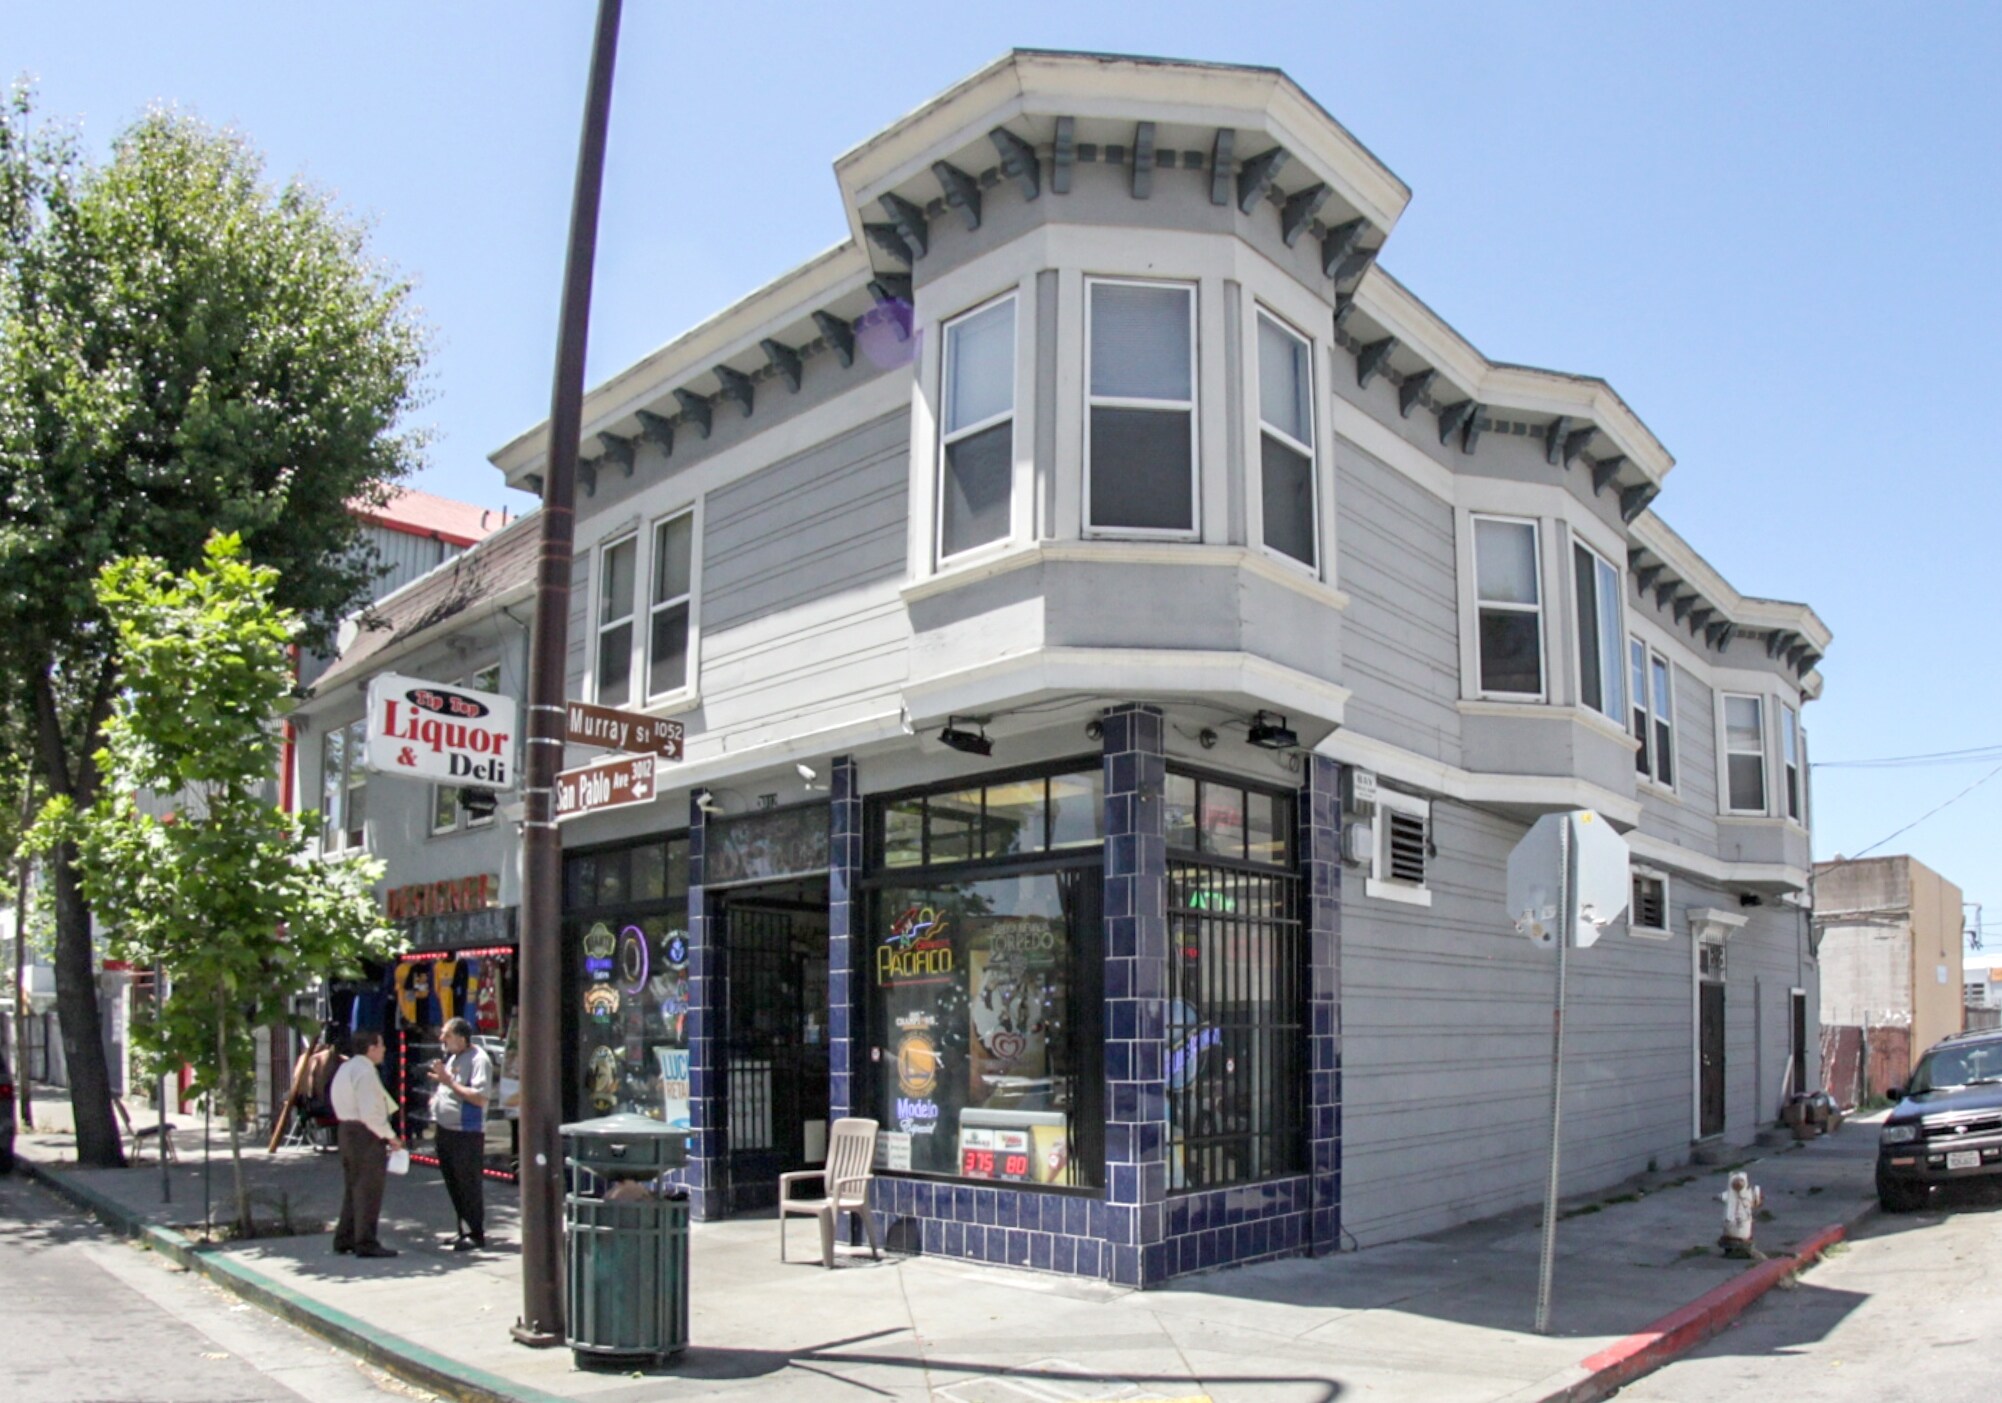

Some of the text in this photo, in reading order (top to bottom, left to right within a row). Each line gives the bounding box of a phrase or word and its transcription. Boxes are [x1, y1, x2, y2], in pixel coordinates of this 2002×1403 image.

[414, 689, 480, 718] Tip Top
[382, 698, 509, 756] Liquor
[570, 707, 629, 746] Murray
[654, 721, 683, 741] 1052
[396, 746, 505, 783] & Deli
[556, 779, 576, 811] San
[579, 770, 611, 807] Pablo
[613, 772, 629, 789] Ave
[661, 1053, 689, 1081] LUC
[897, 1097, 939, 1119] Modelo
[1005, 1155, 1027, 1175] 80
